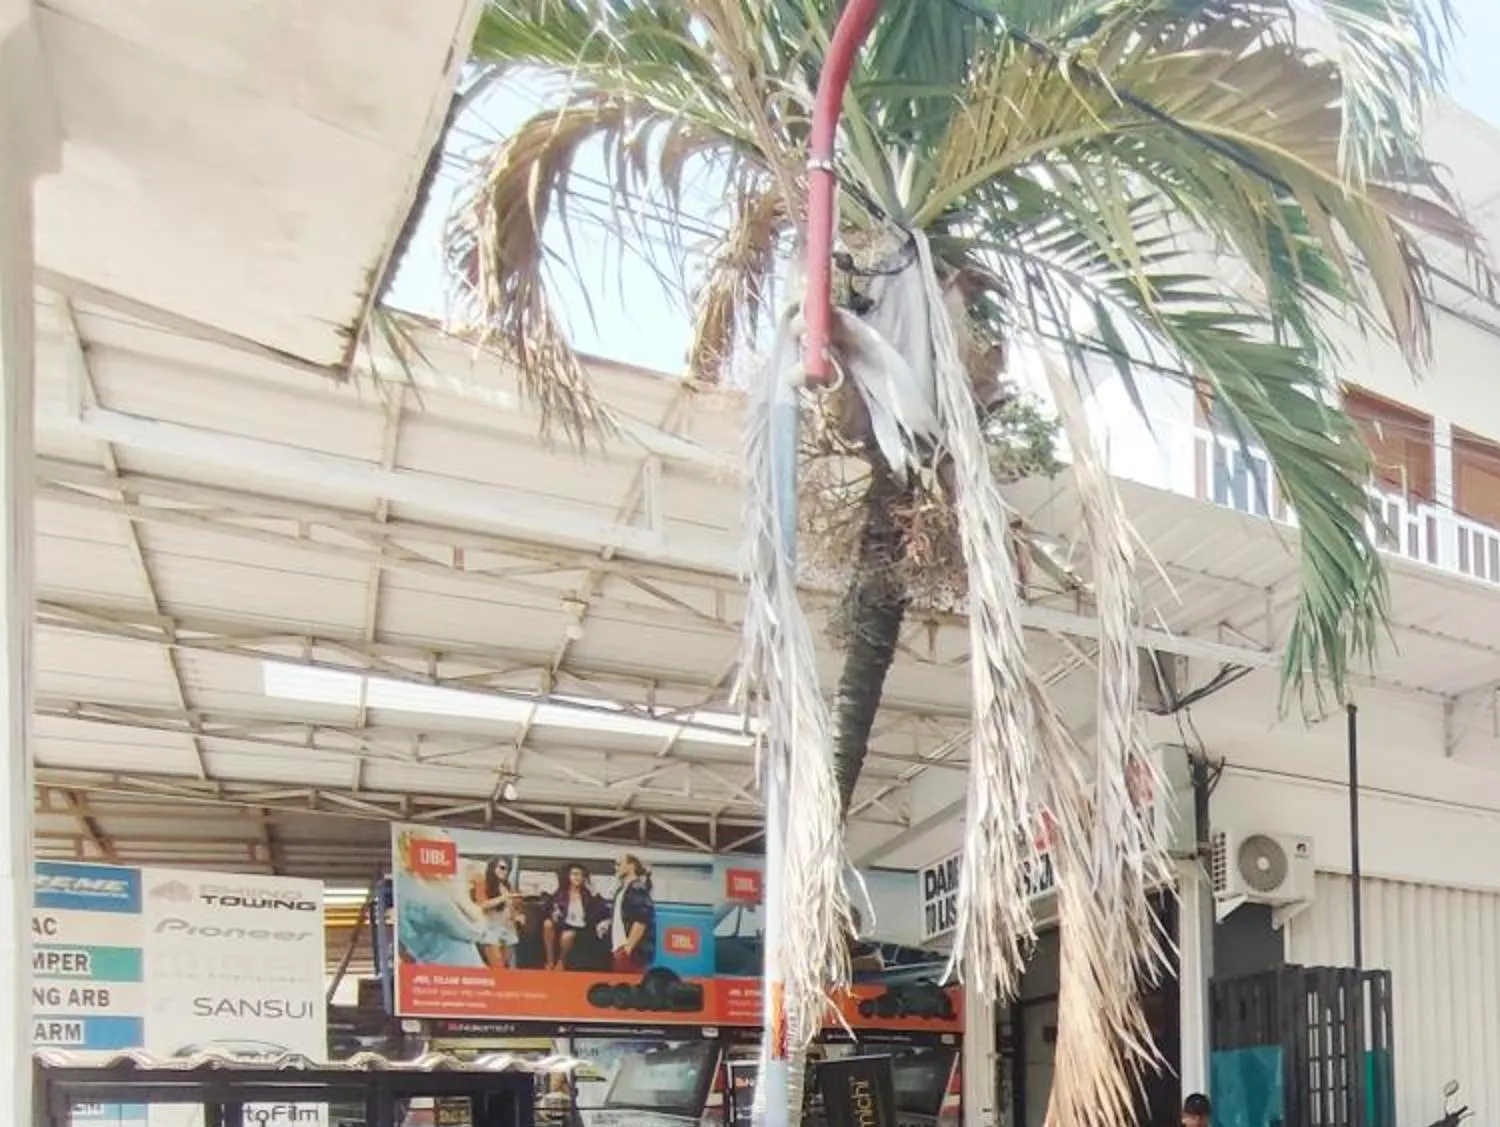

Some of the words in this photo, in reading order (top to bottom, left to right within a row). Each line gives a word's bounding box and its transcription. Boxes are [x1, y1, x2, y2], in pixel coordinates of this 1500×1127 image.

[200, 895, 317, 912] TOWING
[154, 918, 314, 941] Pioneer
[67, 988, 110, 1008] ARB
[193, 997, 314, 1019] SANSUI
